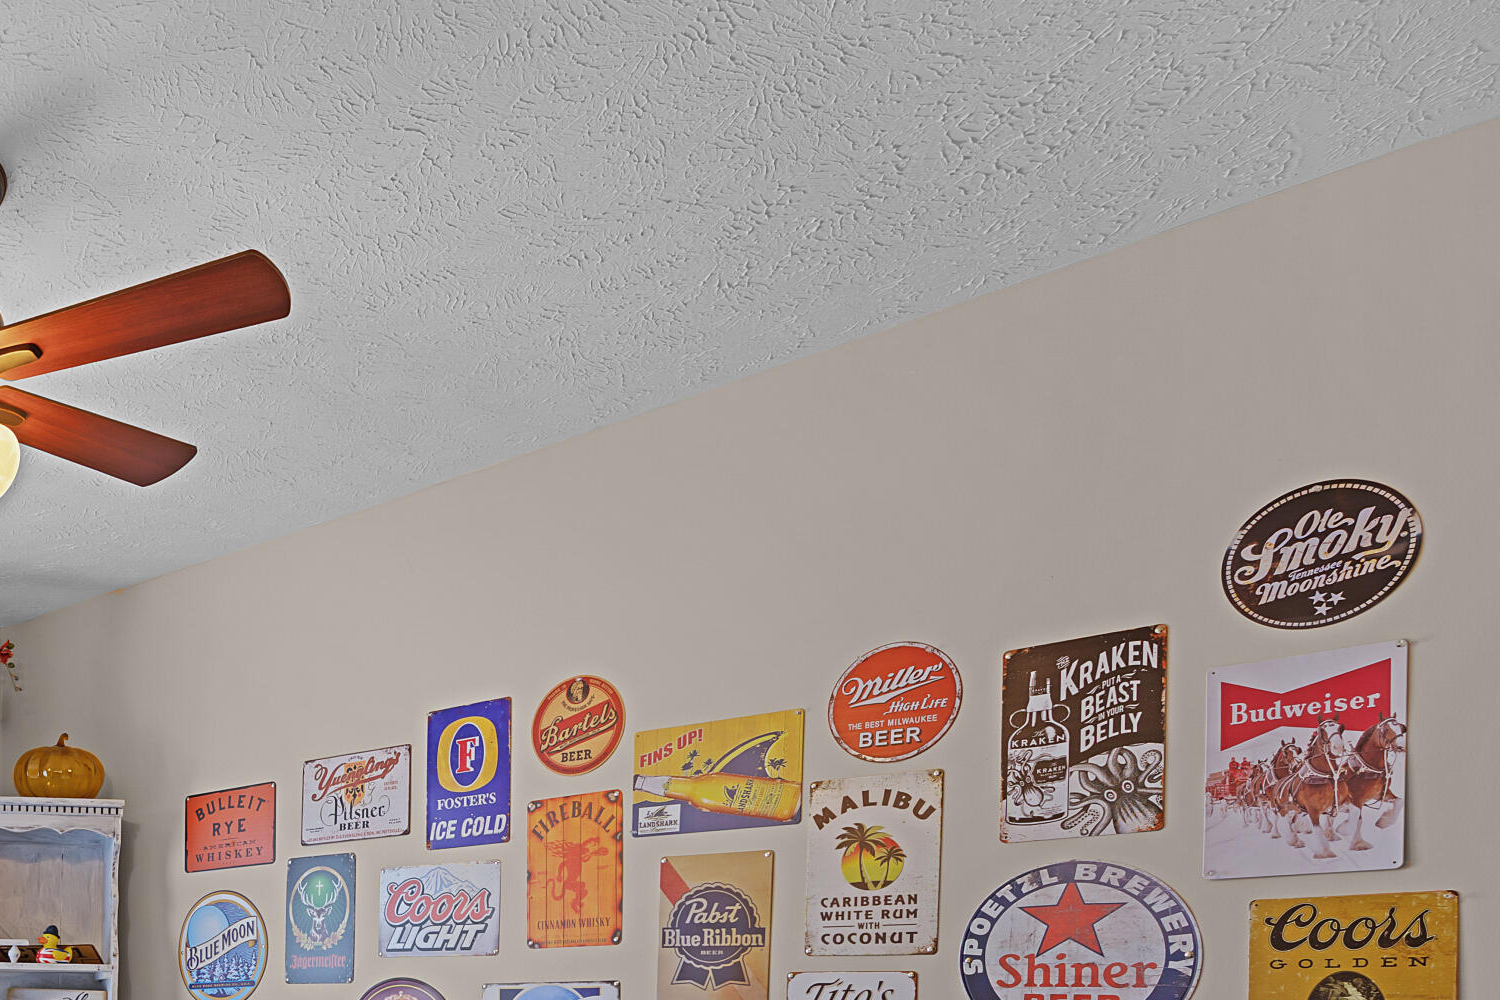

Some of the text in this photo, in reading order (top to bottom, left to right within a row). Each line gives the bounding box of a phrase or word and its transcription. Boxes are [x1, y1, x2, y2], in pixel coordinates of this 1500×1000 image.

[1294, 508, 1355, 539] Ole
[1233, 506, 1411, 585] Smoky
[1255, 555, 1402, 606] Moonshine
[1288, 560, 1342, 582] Tennessee
[842, 662, 944, 705] Miller
[1060, 640, 1159, 701] KRAKEN
[1102, 675, 1121, 689] PUT A
[1080, 680, 1141, 723] BEAST
[1098, 705, 1124, 721] IN YOUR
[1230, 692, 1380, 725] Budweiser
[540, 703, 618, 753] Bartels
[848, 714, 938, 731] THE BEST MILWAUKEE
[1080, 711, 1142, 752] BELLY
[640, 742, 673, 768] FINS
[677, 728, 703, 751] UP!
[859, 726, 921, 748] BEER
[1011, 734, 1065, 748] KRAKEN
[456, 736, 479, 774] F
[561, 749, 592, 763] BEER
[1036, 765, 1066, 774] KRAKEN
[195, 794, 266, 822] BULLEIT
[437, 792, 497, 810] FOSTER'S
[812, 789, 937, 830] MALIBU
[212, 818, 246, 837] RYE
[339, 820, 370, 832] BEER
[430, 819, 457, 841] ICE
[461, 814, 507, 838] COLD
[532, 800, 616, 842] FIREBALL
[196, 847, 264, 863] WHISKEY
[384, 877, 496, 927] Coors
[684, 897, 742, 924] Pabst
[820, 894, 918, 908] CARIBBEAN
[820, 908, 918, 921] WHITE RUM
[537, 919, 576, 930] CINNAMON
[857, 922, 880, 930] WITH
[964, 863, 1195, 977] SPOETZL BREWERY
[1264, 903, 1437, 951] Coors
[187, 921, 255, 971] BLUE MOON
[386, 923, 488, 952] LIGHT
[663, 928, 765, 947] Blue Ribbon
[821, 931, 918, 945] COCONUT
[996, 953, 1158, 988] Shiner
[1269, 956, 1430, 970] GOLDEN
